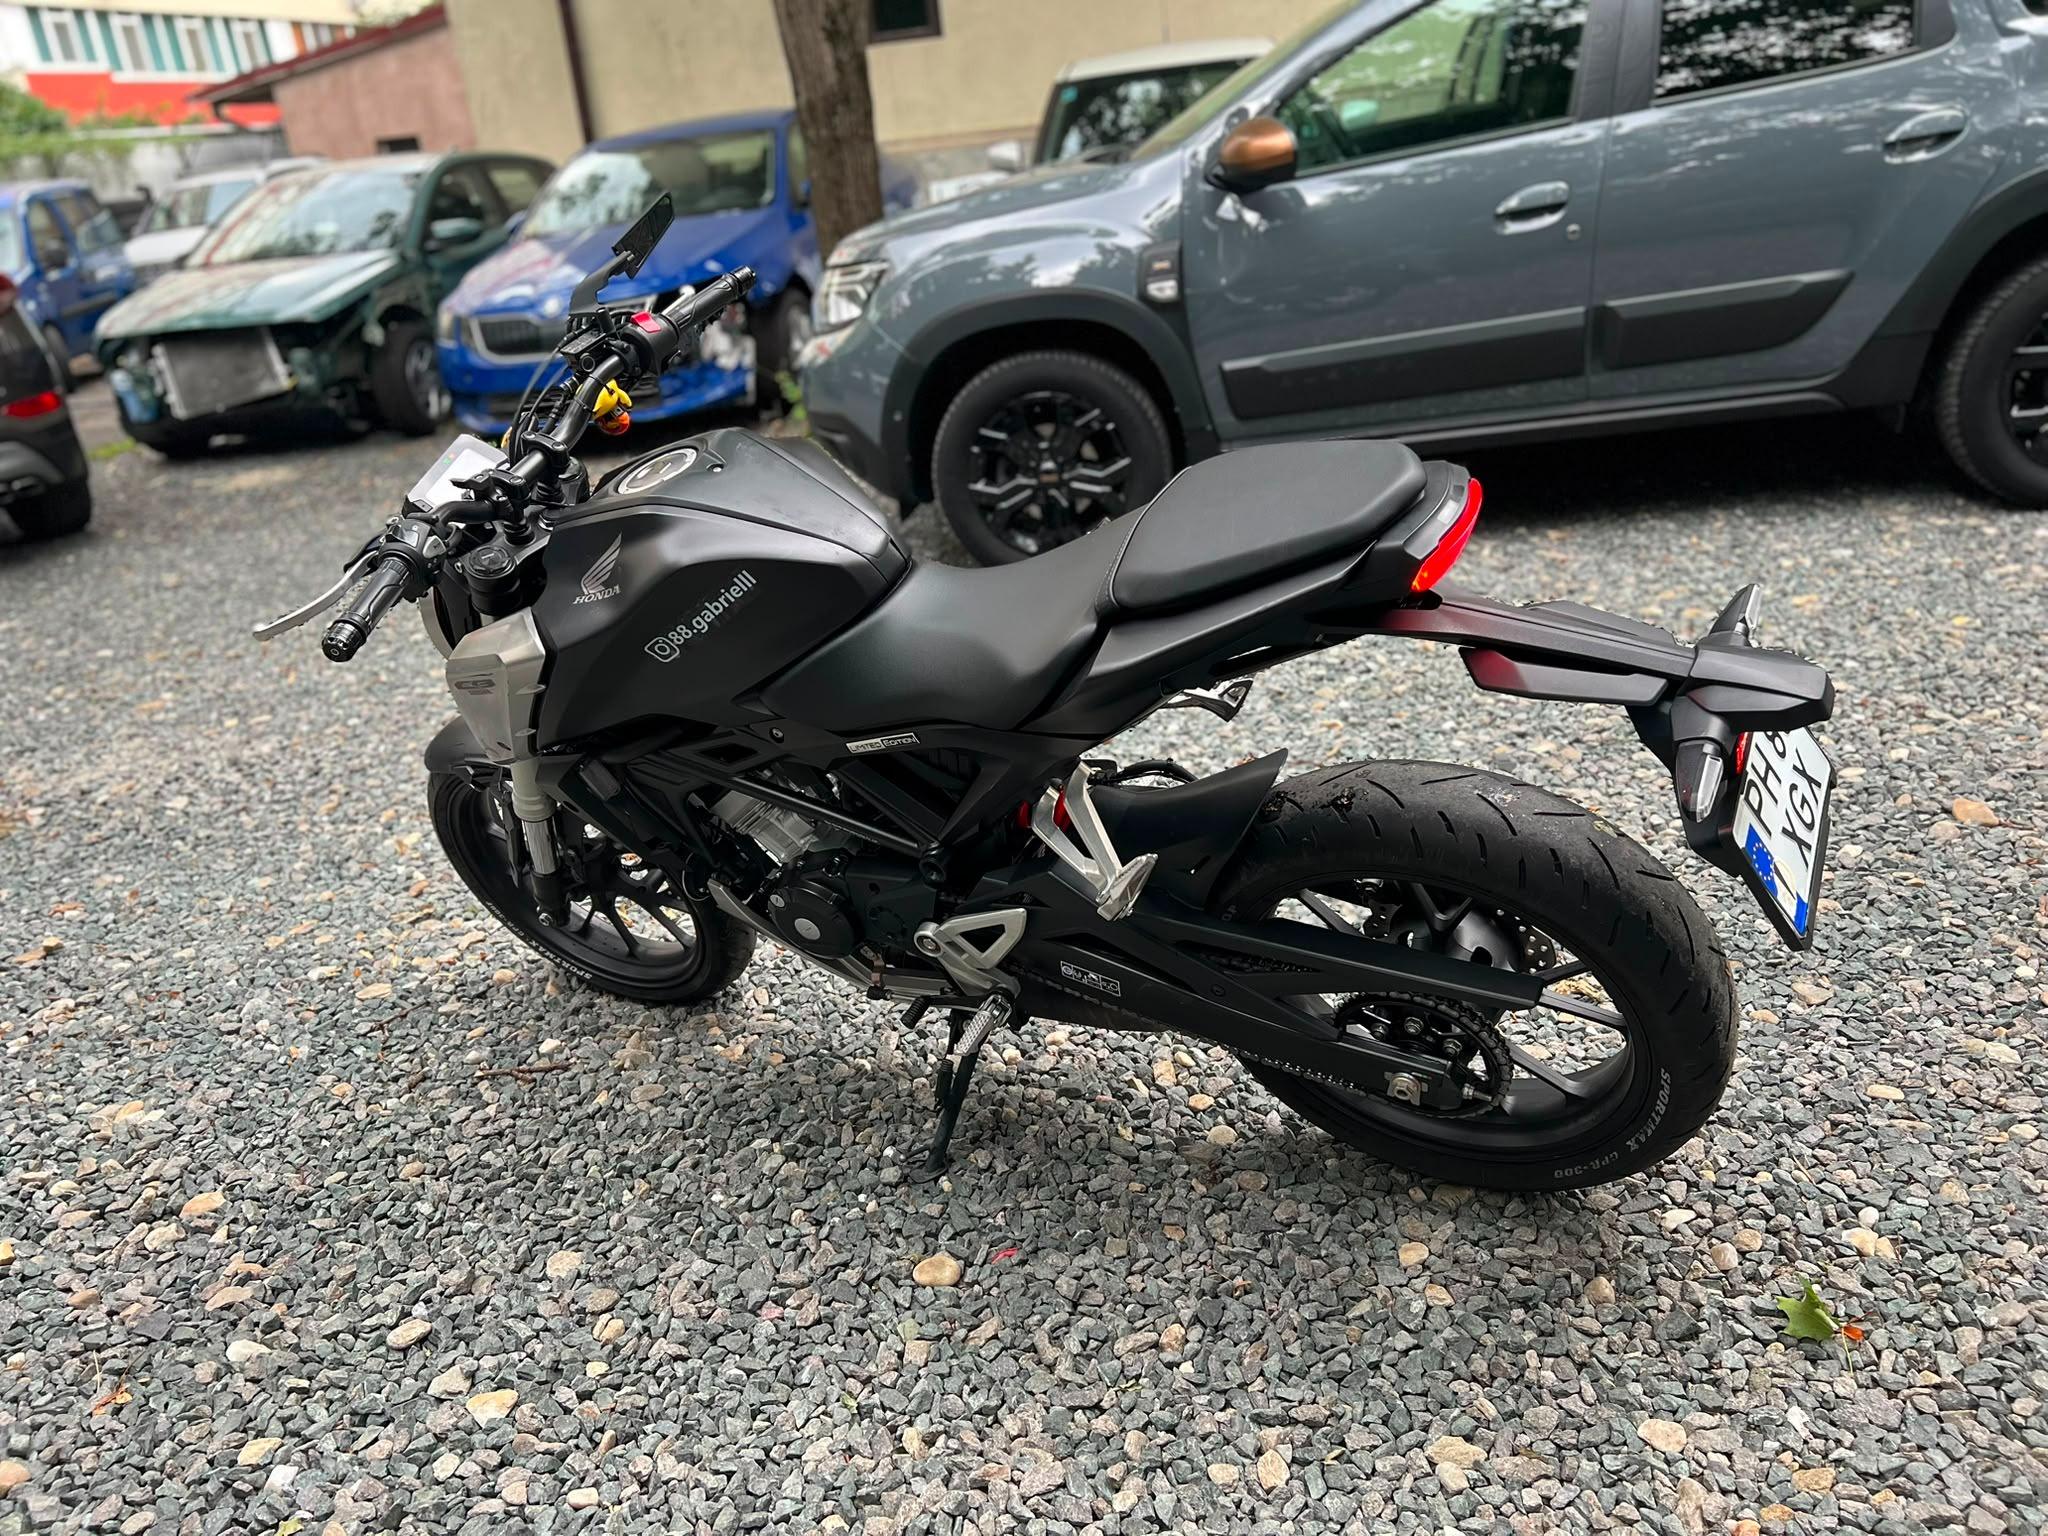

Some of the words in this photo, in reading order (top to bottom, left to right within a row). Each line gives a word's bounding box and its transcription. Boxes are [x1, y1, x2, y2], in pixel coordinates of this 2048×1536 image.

[573, 584, 621, 605] HONDA
[1781, 748, 1822, 870] XGX
[1625, 1067, 1671, 1152] SPORTMAX
